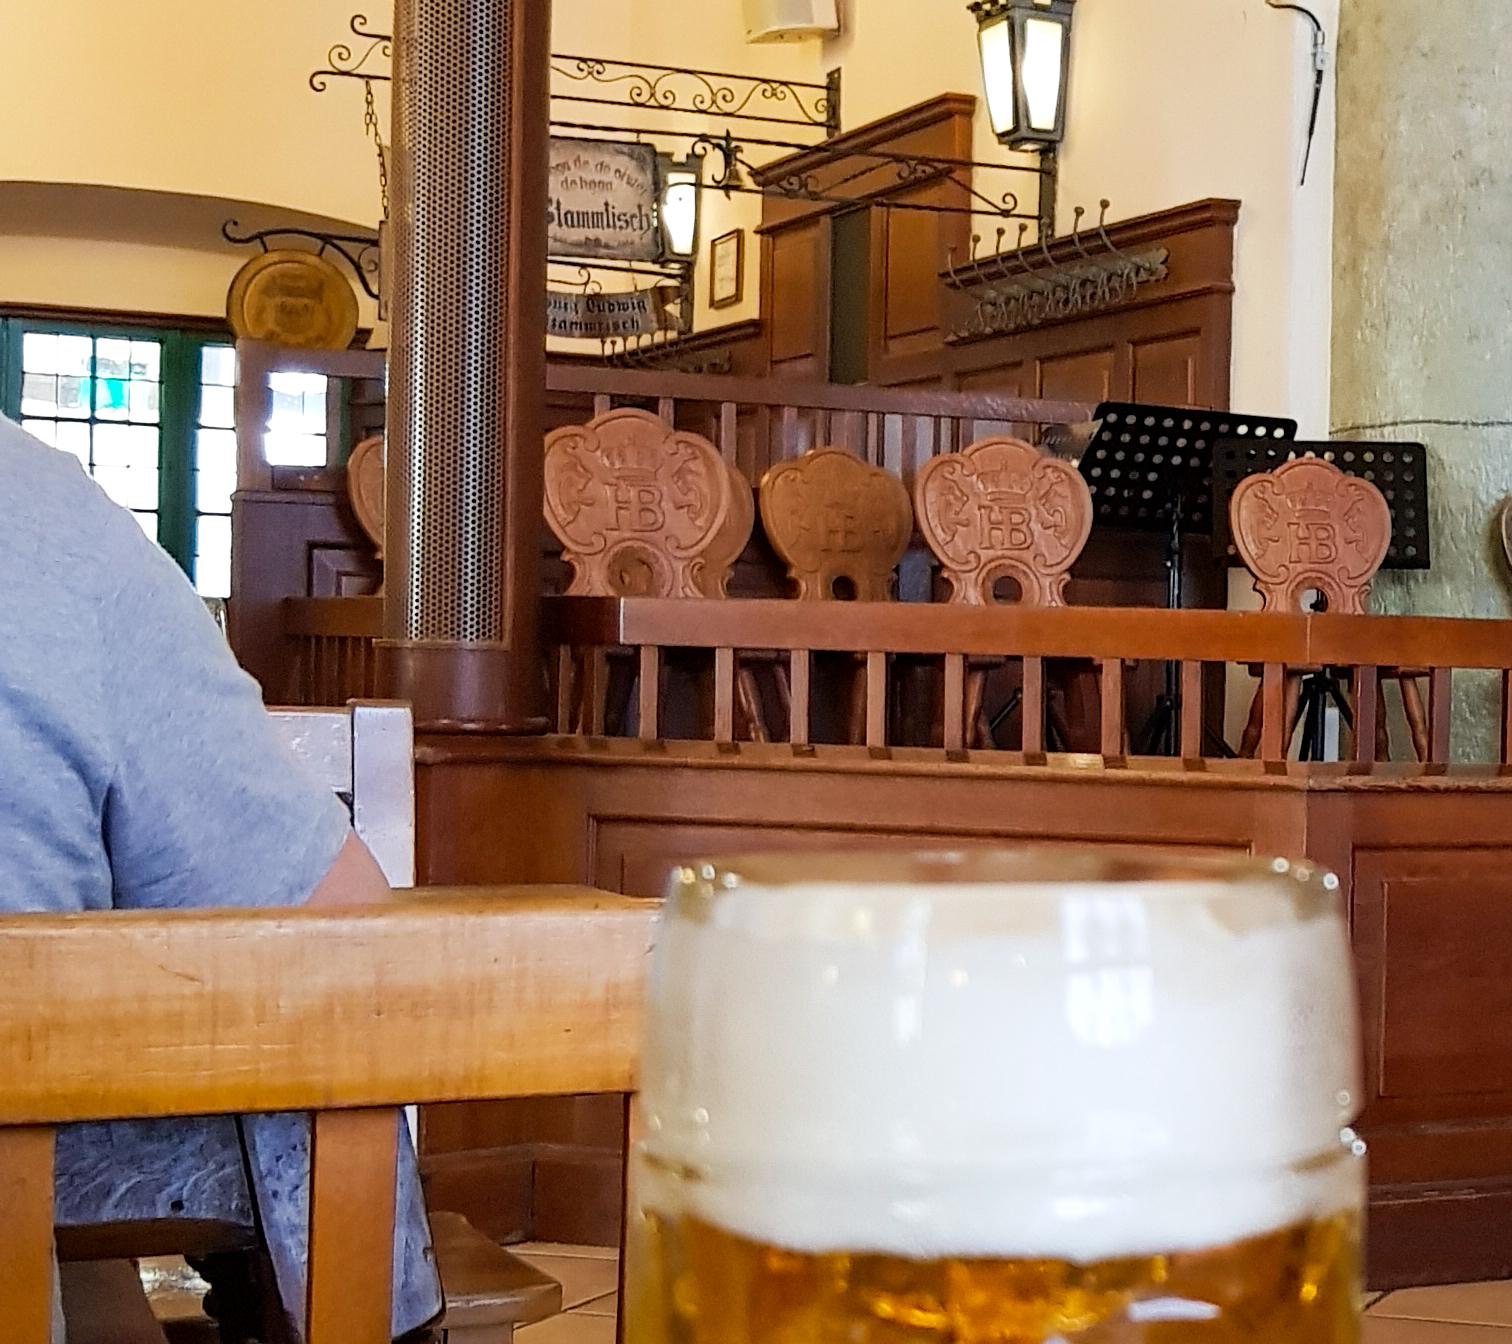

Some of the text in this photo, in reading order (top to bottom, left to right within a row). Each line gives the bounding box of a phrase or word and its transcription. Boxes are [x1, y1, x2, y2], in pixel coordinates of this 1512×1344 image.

[551, 315, 640, 333] tammtisch
[602, 482, 666, 533] HB
[976, 505, 1034, 551] HB
[1287, 521, 1338, 565] HB
